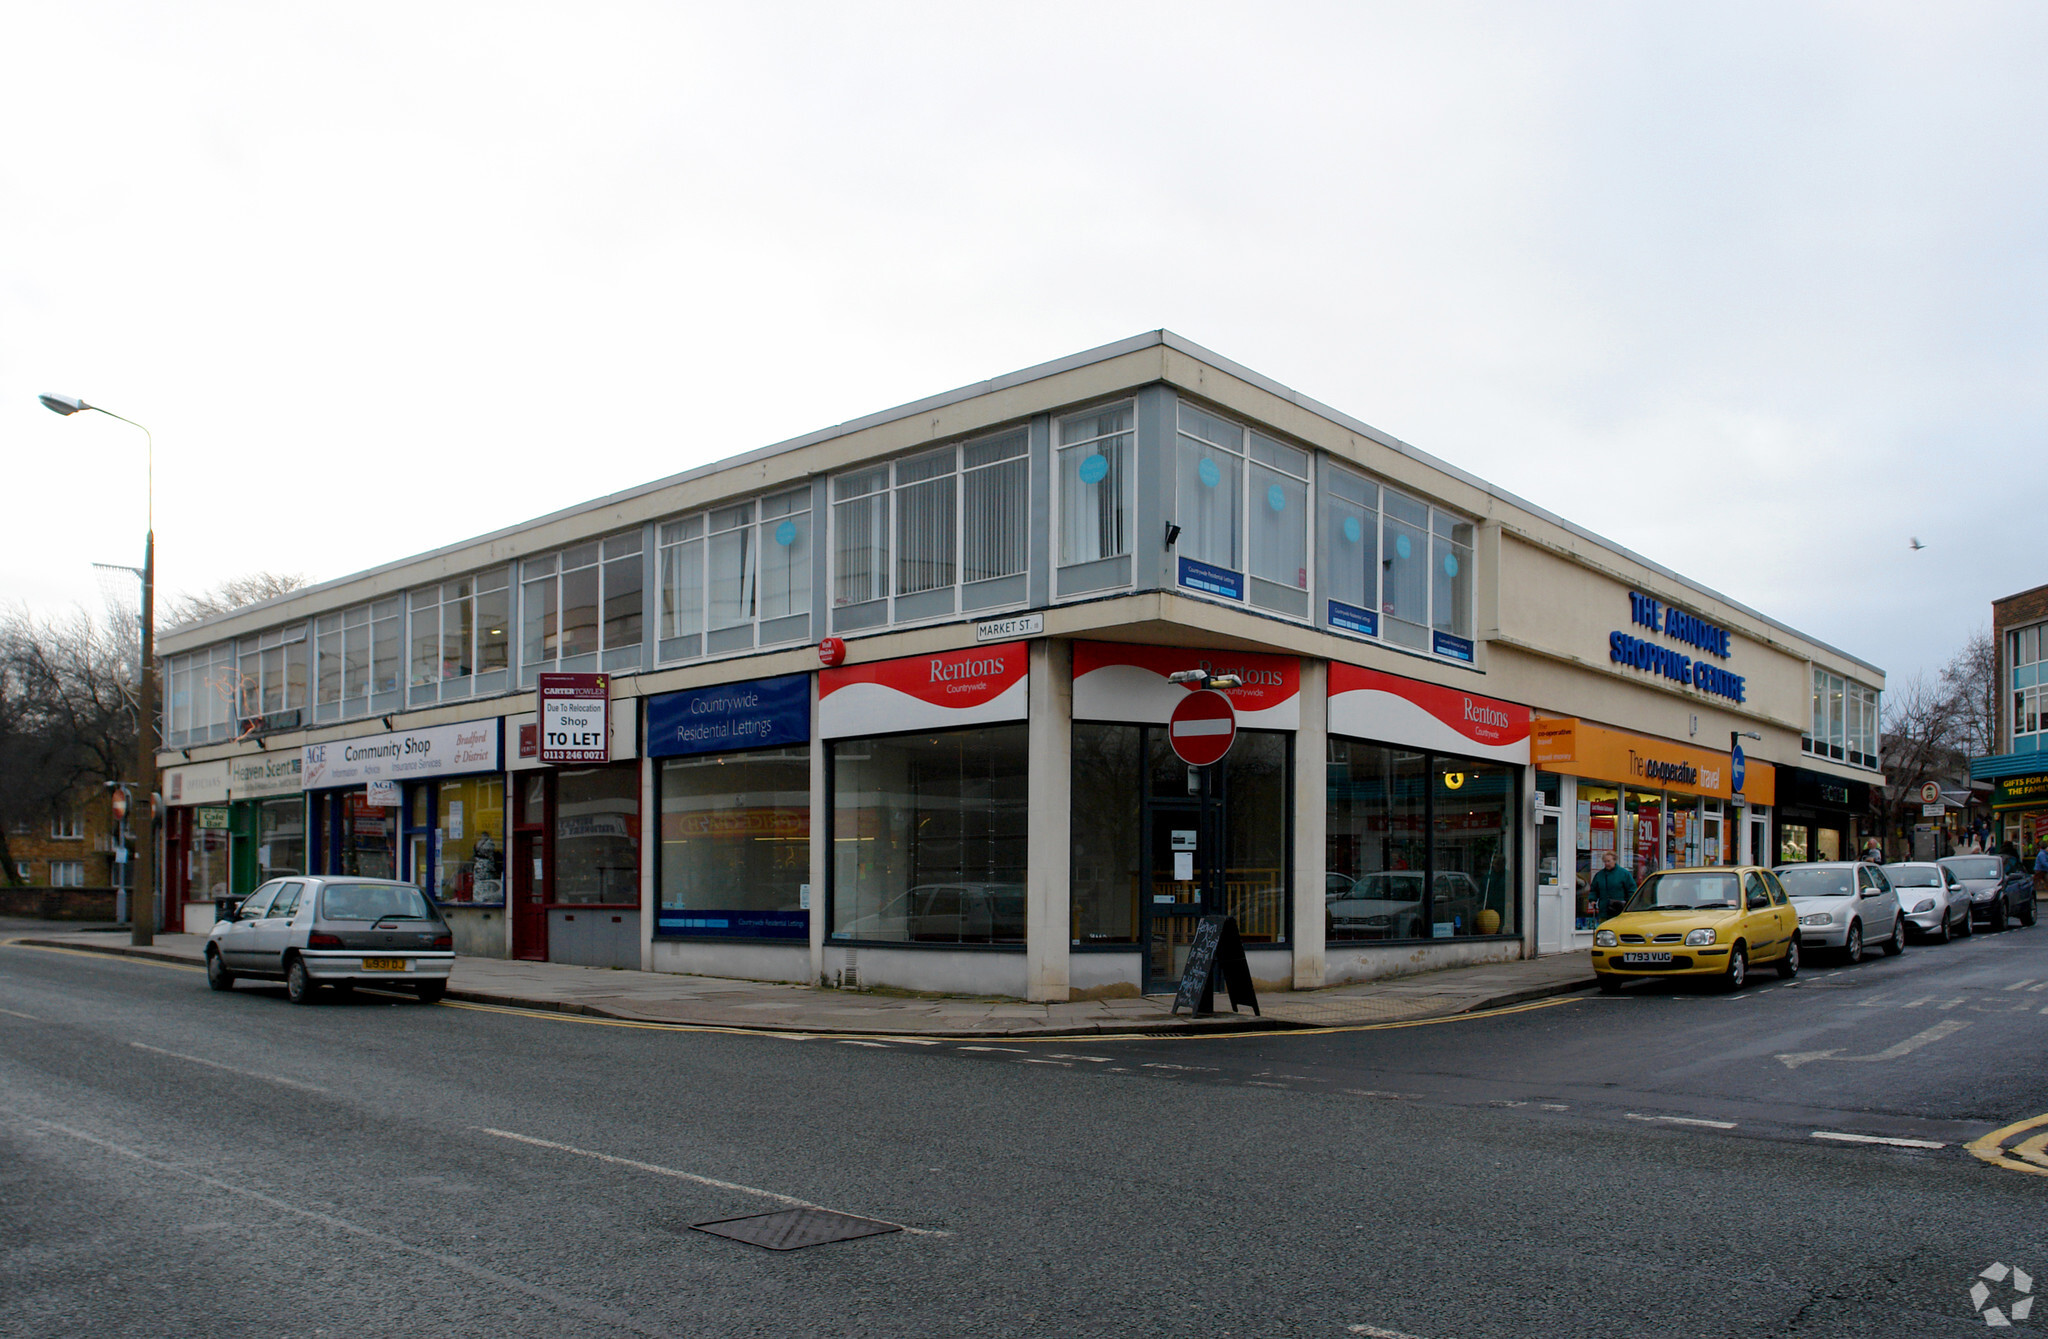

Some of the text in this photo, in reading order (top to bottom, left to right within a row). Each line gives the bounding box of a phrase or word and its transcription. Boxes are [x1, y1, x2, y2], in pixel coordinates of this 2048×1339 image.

[979, 621, 1016, 636] MARKET
[1629, 591, 1731, 659] THE ARNDALE
[929, 657, 1005, 682] Rentons
[1610, 630, 1746, 703] SHOPPING CENTRE
[946, 681, 987, 694] Countrywide
[1224, 688, 1264, 697] ountrywide
[547, 703, 602, 712] Due To Relocation
[690, 692, 758, 715] Countrywide
[1464, 697, 1509, 728] Rentons
[560, 716, 588, 728] Shop
[677, 719, 772, 742] Residential Lettings
[1475, 726, 1500, 739] Countrywide
[1538, 729, 1572, 737] co-operative
[547, 733, 601, 745] TO LET
[306, 745, 327, 764] AGE
[345, 737, 431, 761] Community Shop
[463, 749, 489, 763] District
[543, 751, 605, 760] 0113 246 0071
[232, 759, 290, 782] Heaven Scent
[1628, 749, 1720, 790] The co-operative travel
[2003, 778, 2025, 788] GIFTS
[2025, 777, 2042, 785] FOR
[2008, 785, 2048, 796] THE FAMIL
[1639, 820, 1652, 842] £10
[365, 959, 390, 968] L931
[1624, 953, 1671, 961] T793 VUG
